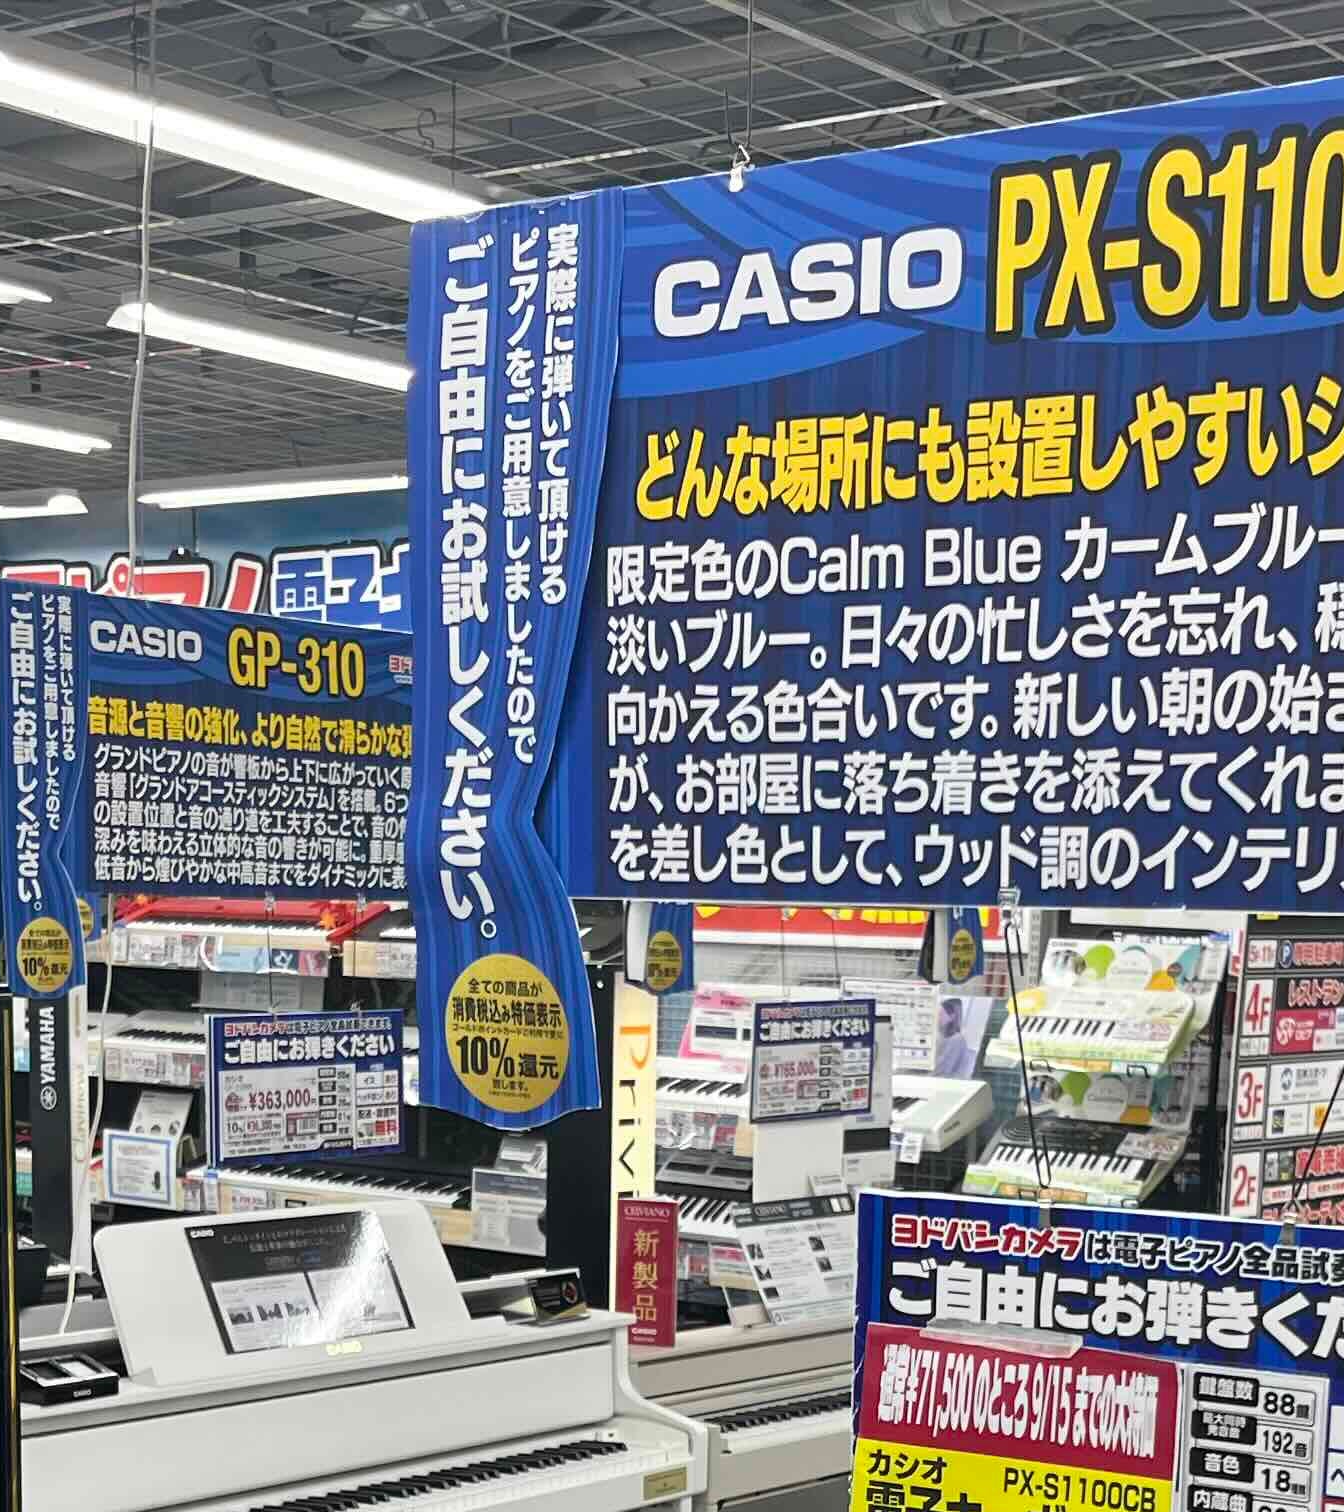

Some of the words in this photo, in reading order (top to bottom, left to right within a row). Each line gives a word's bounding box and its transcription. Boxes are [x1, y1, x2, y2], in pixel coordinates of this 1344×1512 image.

[654, 228, 963, 338] CASIO
[537, 223, 580, 605] 実際に弾いて頂ける
[501, 227, 540, 764] ピアノをご用意しましたので
[438, 233, 497, 938] ご自由にお試しください。
[607, 534, 904, 608] 限定色のCalm
[924, 527, 1042, 588] Blue
[88, 619, 203, 664] CASIO
[228, 626, 366, 698] GP-310
[9, 591, 44, 912] ご自由にお試しください。
[94, 854, 408, 890] 低音から煌びやかな中高音までをダイナミックに表
[21, 955, 50, 978] 10%
[468, 978, 543, 998] 全ての商品が
[452, 997, 562, 1028] 消費税込み特価表示
[1243, 981, 1272, 1034] 4F
[39, 1005, 57, 1084] YAMAHA
[456, 1035, 515, 1078] 10%
[518, 1053, 559, 1079] 還元
[1236, 1070, 1265, 1120] 3F
[1232, 1164, 1257, 1208] 2F
[632, 1228, 658, 1322] 新製品
[865, 1448, 948, 1485] カシオ
[1203, 1453, 1241, 1475] 音色
[1192, 1489, 1248, 1512] 内蔵曲
